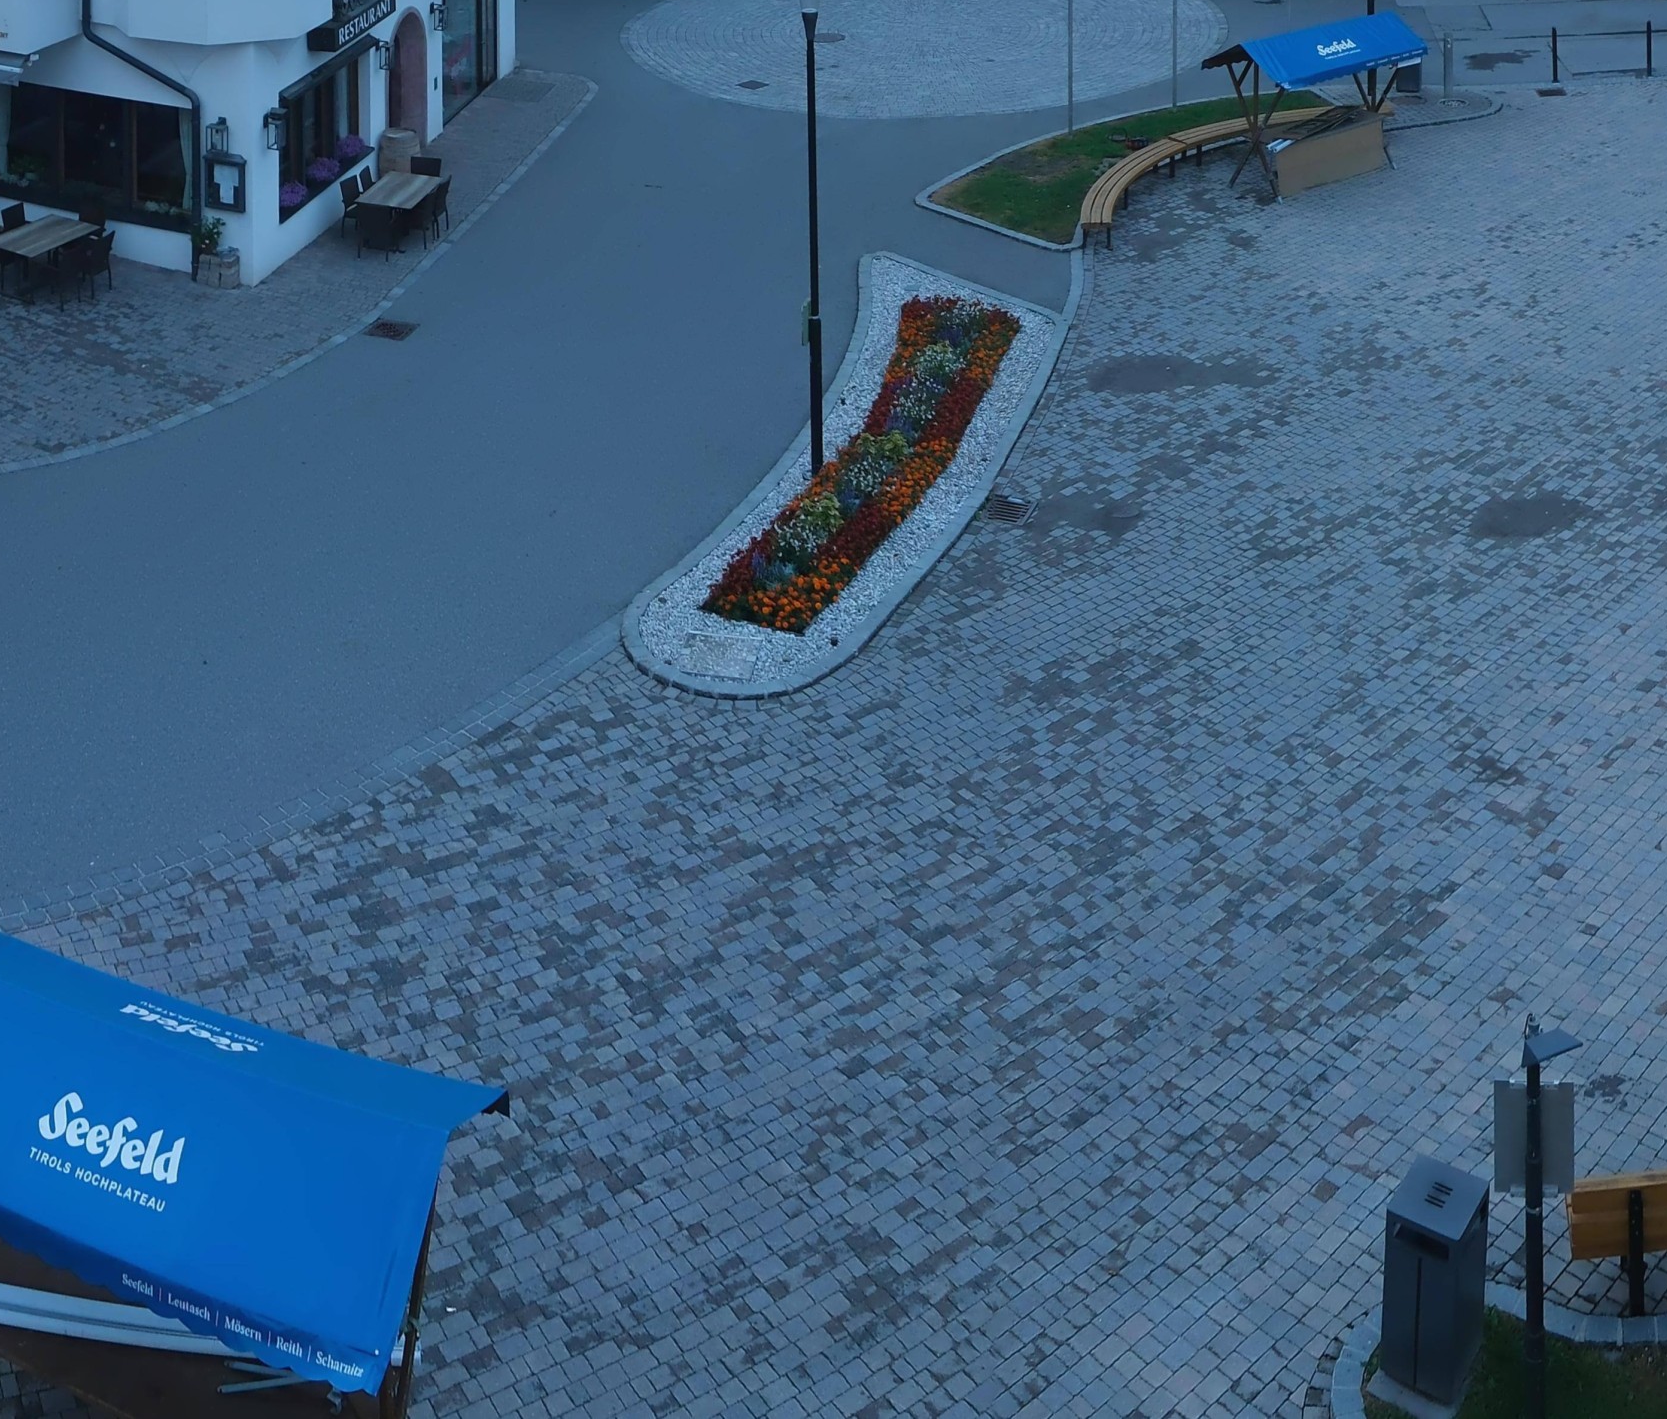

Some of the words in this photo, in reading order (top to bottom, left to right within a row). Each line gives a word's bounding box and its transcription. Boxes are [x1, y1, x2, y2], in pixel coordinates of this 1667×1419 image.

[1316, 38, 1357, 56] Seefeld
[119, 1003, 259, 1052] Seefeld
[140, 1000, 222, 1033] HOCHPLATEAU
[38, 1091, 186, 1185] Seefeld
[29, 1146, 71, 1174] TIROLS
[75, 1166, 166, 1213] HOCHPLATEAU
[121, 1272, 154, 1298] Seefeld
[167, 1292, 211, 1321] Leutasch
[224, 1315, 262, 1342] Mösern
[275, 1335, 303, 1359] Reith
[315, 1350, 365, 1378] Scharnitz
